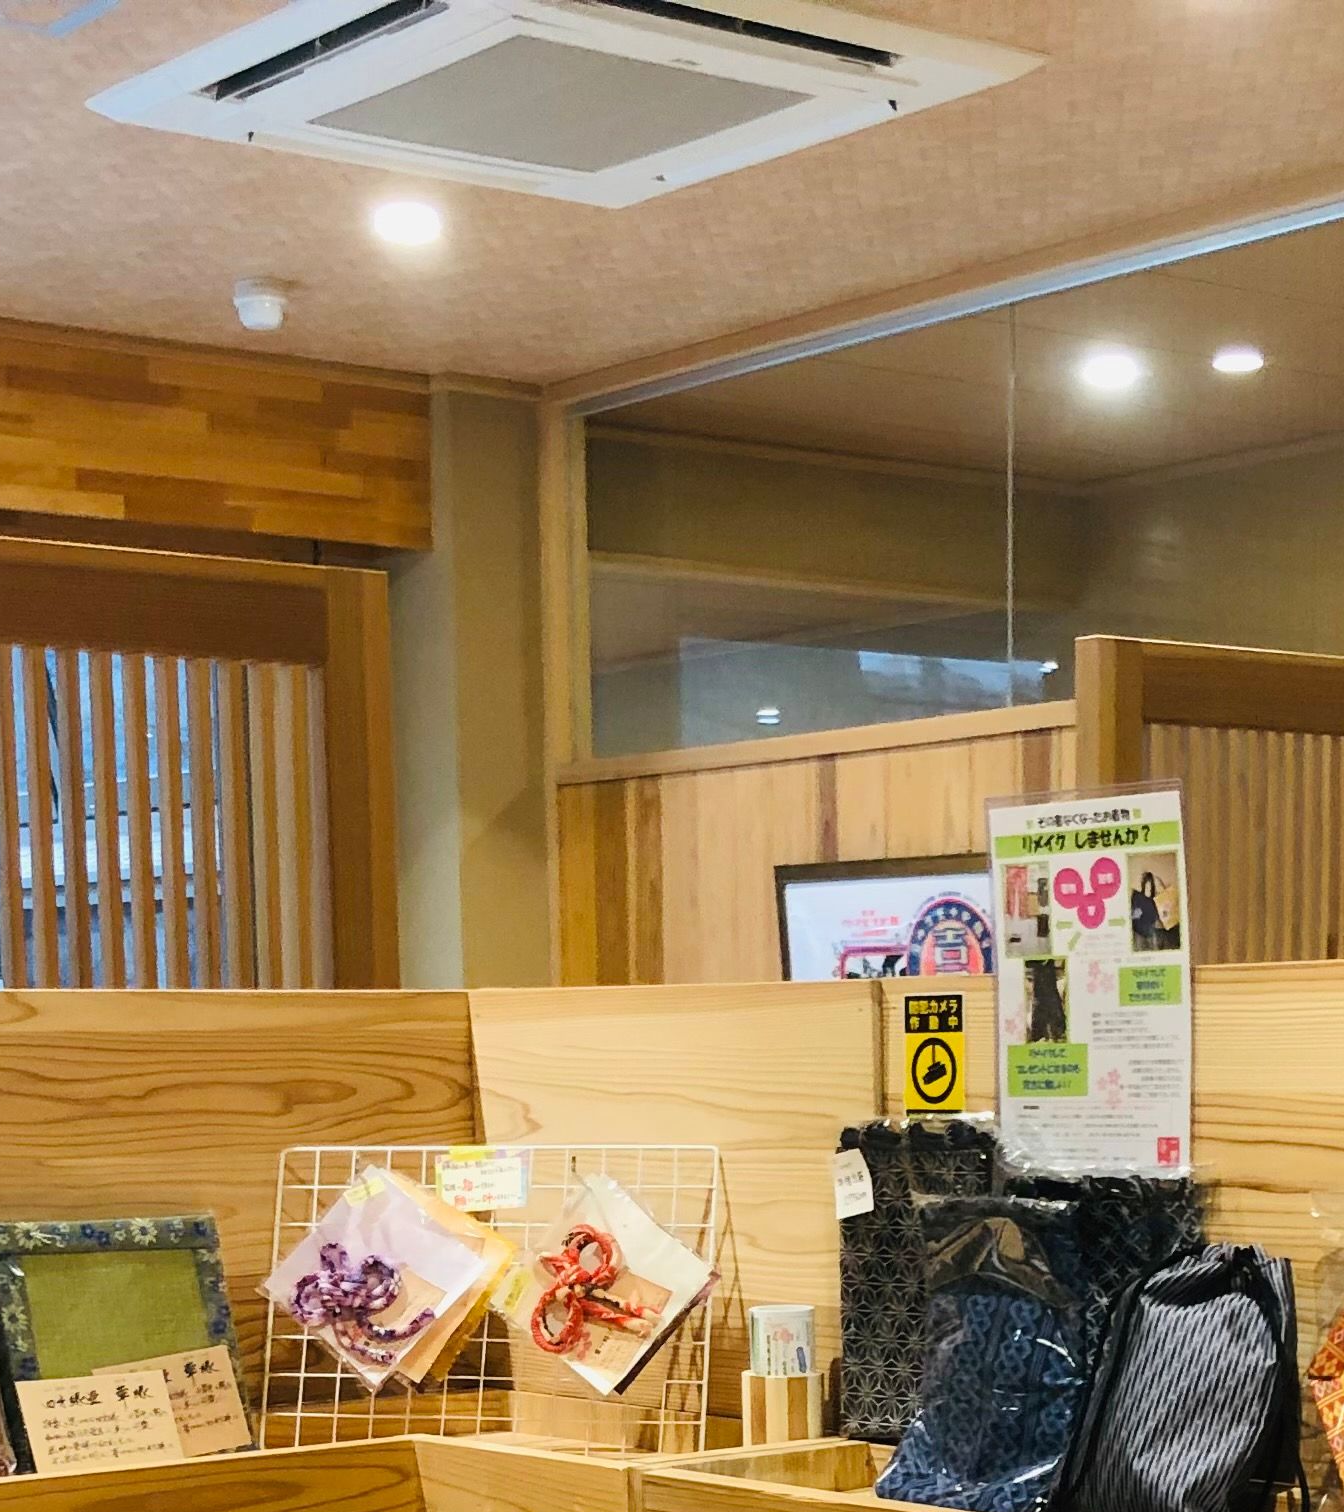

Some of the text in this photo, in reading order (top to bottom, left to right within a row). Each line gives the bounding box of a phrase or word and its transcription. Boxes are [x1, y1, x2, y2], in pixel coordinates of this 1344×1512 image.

[1022, 832, 1066, 853] リメイク
[910, 1015, 959, 1031] 作動中
